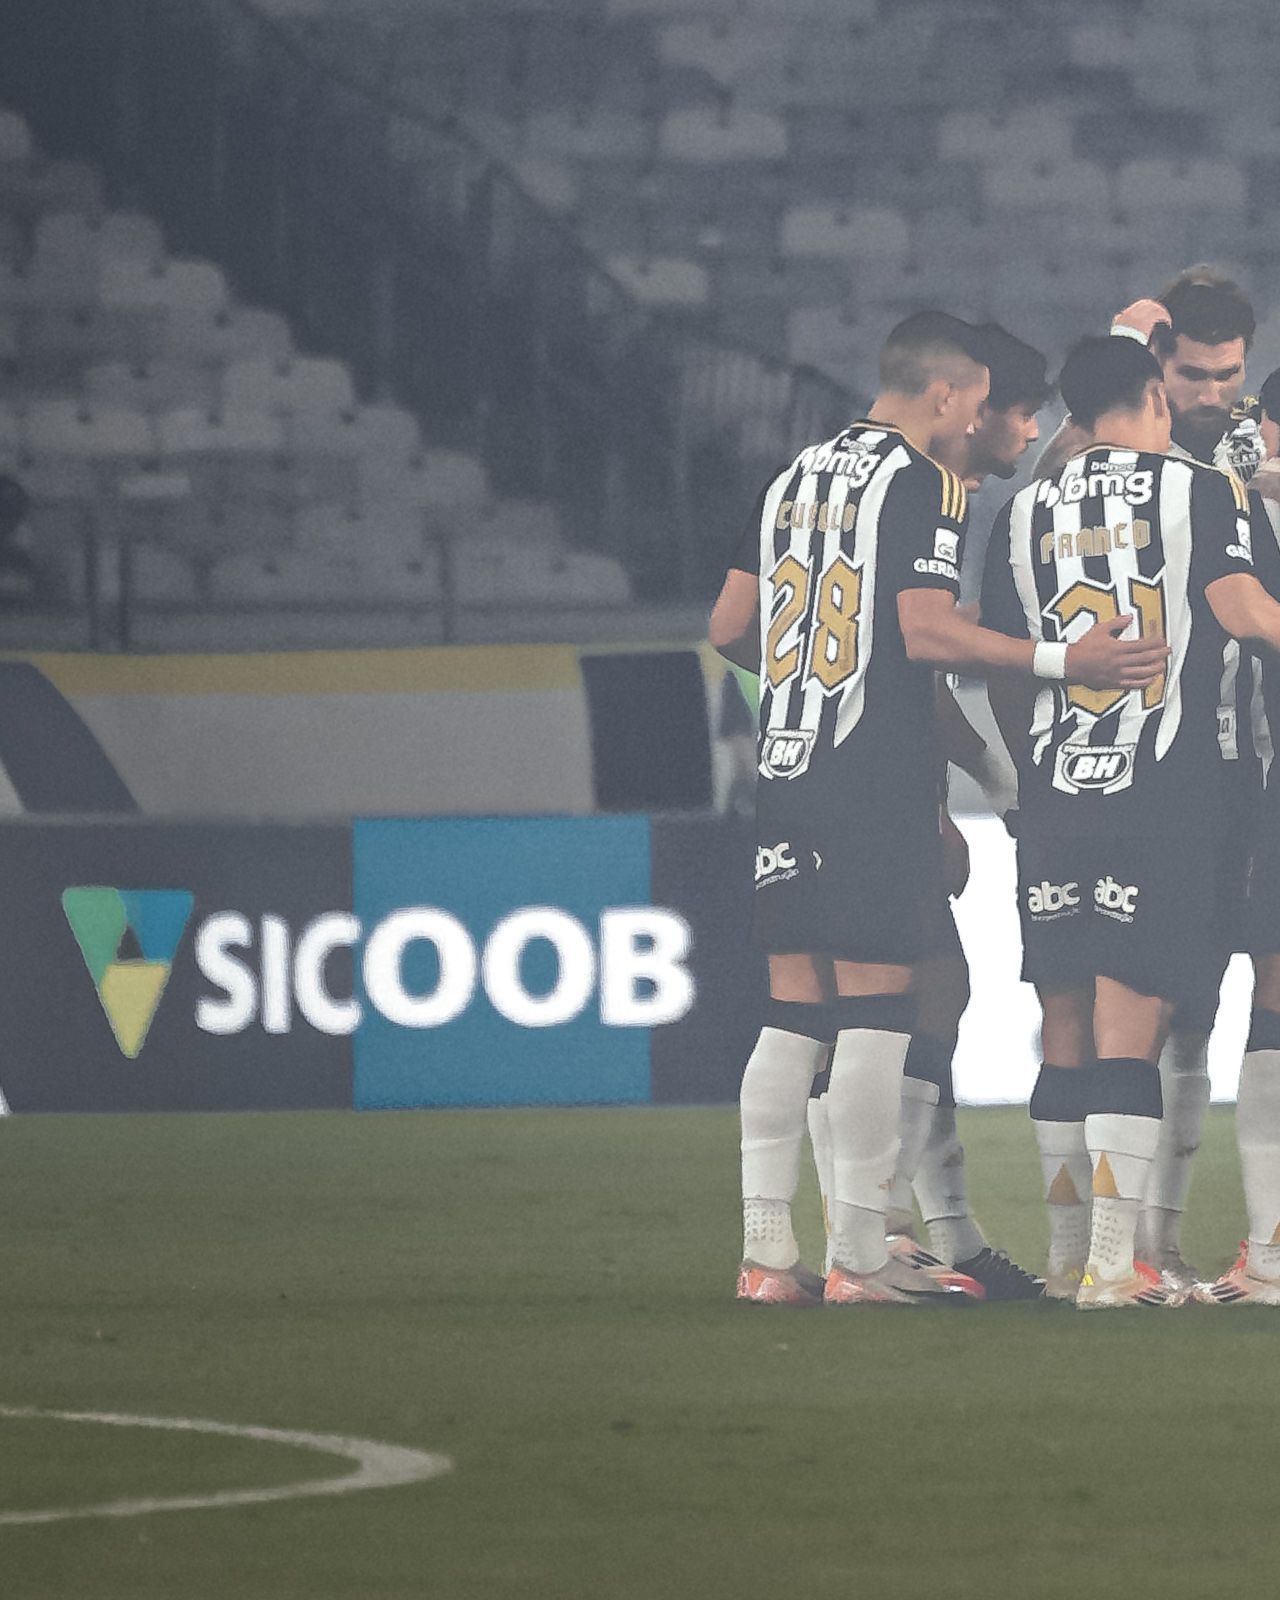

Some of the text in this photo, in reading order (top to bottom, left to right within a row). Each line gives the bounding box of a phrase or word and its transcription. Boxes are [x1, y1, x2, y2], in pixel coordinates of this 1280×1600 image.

[812, 447, 881, 489] bmg
[1061, 470, 1153, 506] bmg
[1040, 518, 1151, 565] FRANCO
[766, 552, 864, 695] 28
[1046, 570, 1168, 717] 21
[769, 738, 803, 767] BH
[1071, 754, 1121, 780] BH
[1027, 880, 1080, 913] abc
[1093, 875, 1139, 913] abc
[195, 906, 696, 1035] SICOOB
